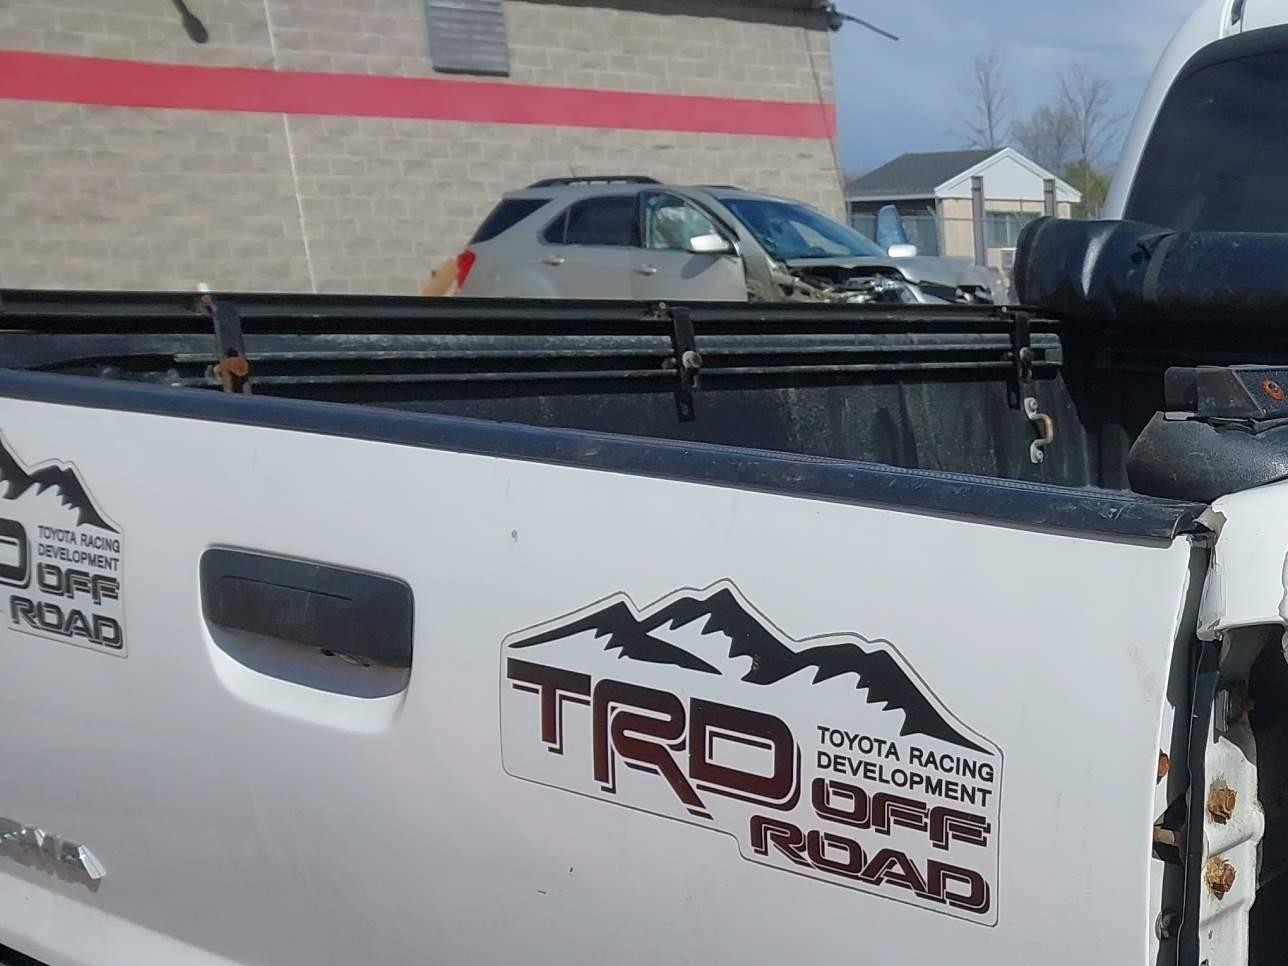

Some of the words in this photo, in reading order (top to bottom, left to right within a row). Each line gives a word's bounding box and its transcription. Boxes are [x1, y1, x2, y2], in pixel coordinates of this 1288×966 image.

[37, 525, 77, 545] TOYOTA
[80, 533, 121, 553] RACING
[37, 543, 120, 571] DEVELOPMENT
[37, 562, 120, 605] OFF
[9, 595, 123, 650] ROAD
[507, 658, 801, 820] TRD
[817, 726, 900, 761] TOYOTA
[909, 746, 994, 783] RACING
[817, 751, 992, 807] DEVELOPMENT
[811, 777, 991, 851] OFF
[750, 815, 991, 915] ROAD
